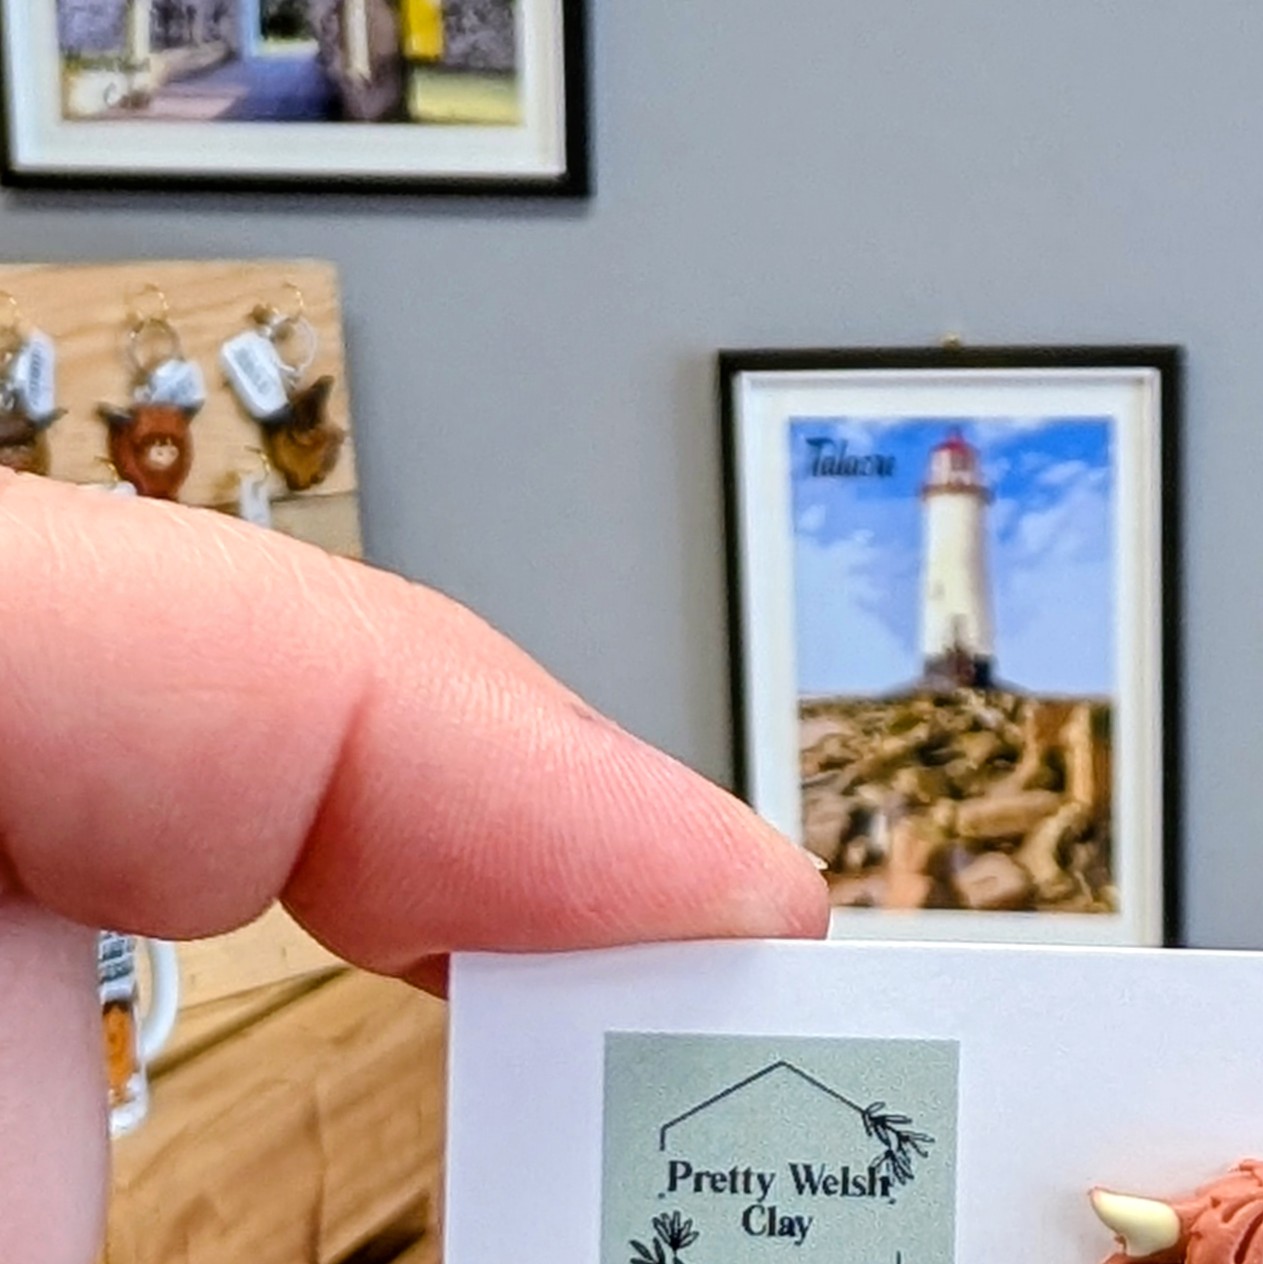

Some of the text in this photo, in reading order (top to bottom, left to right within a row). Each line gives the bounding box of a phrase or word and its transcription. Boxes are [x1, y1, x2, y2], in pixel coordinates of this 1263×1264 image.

[667, 1160, 892, 1202] Pretty Welsh
[742, 1204, 813, 1247] Clay
